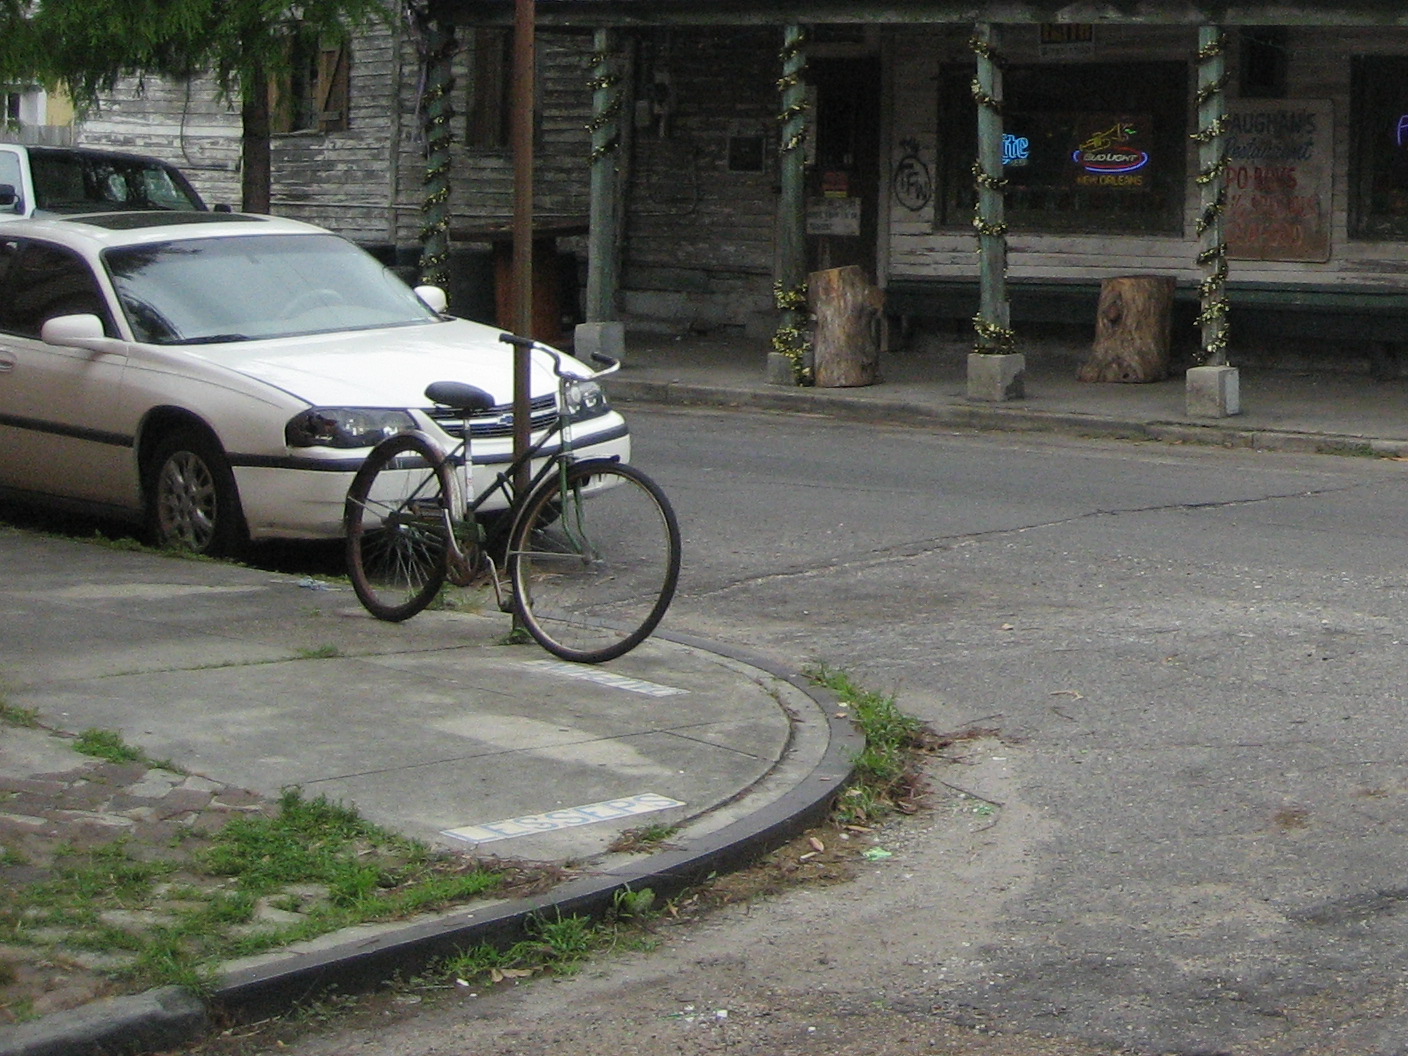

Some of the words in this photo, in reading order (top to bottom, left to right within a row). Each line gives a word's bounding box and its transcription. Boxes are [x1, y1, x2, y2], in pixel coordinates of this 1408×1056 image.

[1226, 110, 1317, 135] AUGHAN'S
[1076, 175, 1099, 186] NEW
[1099, 175, 1143, 186] ORLEANS
[442, 793, 682, 843] LESSEPS
